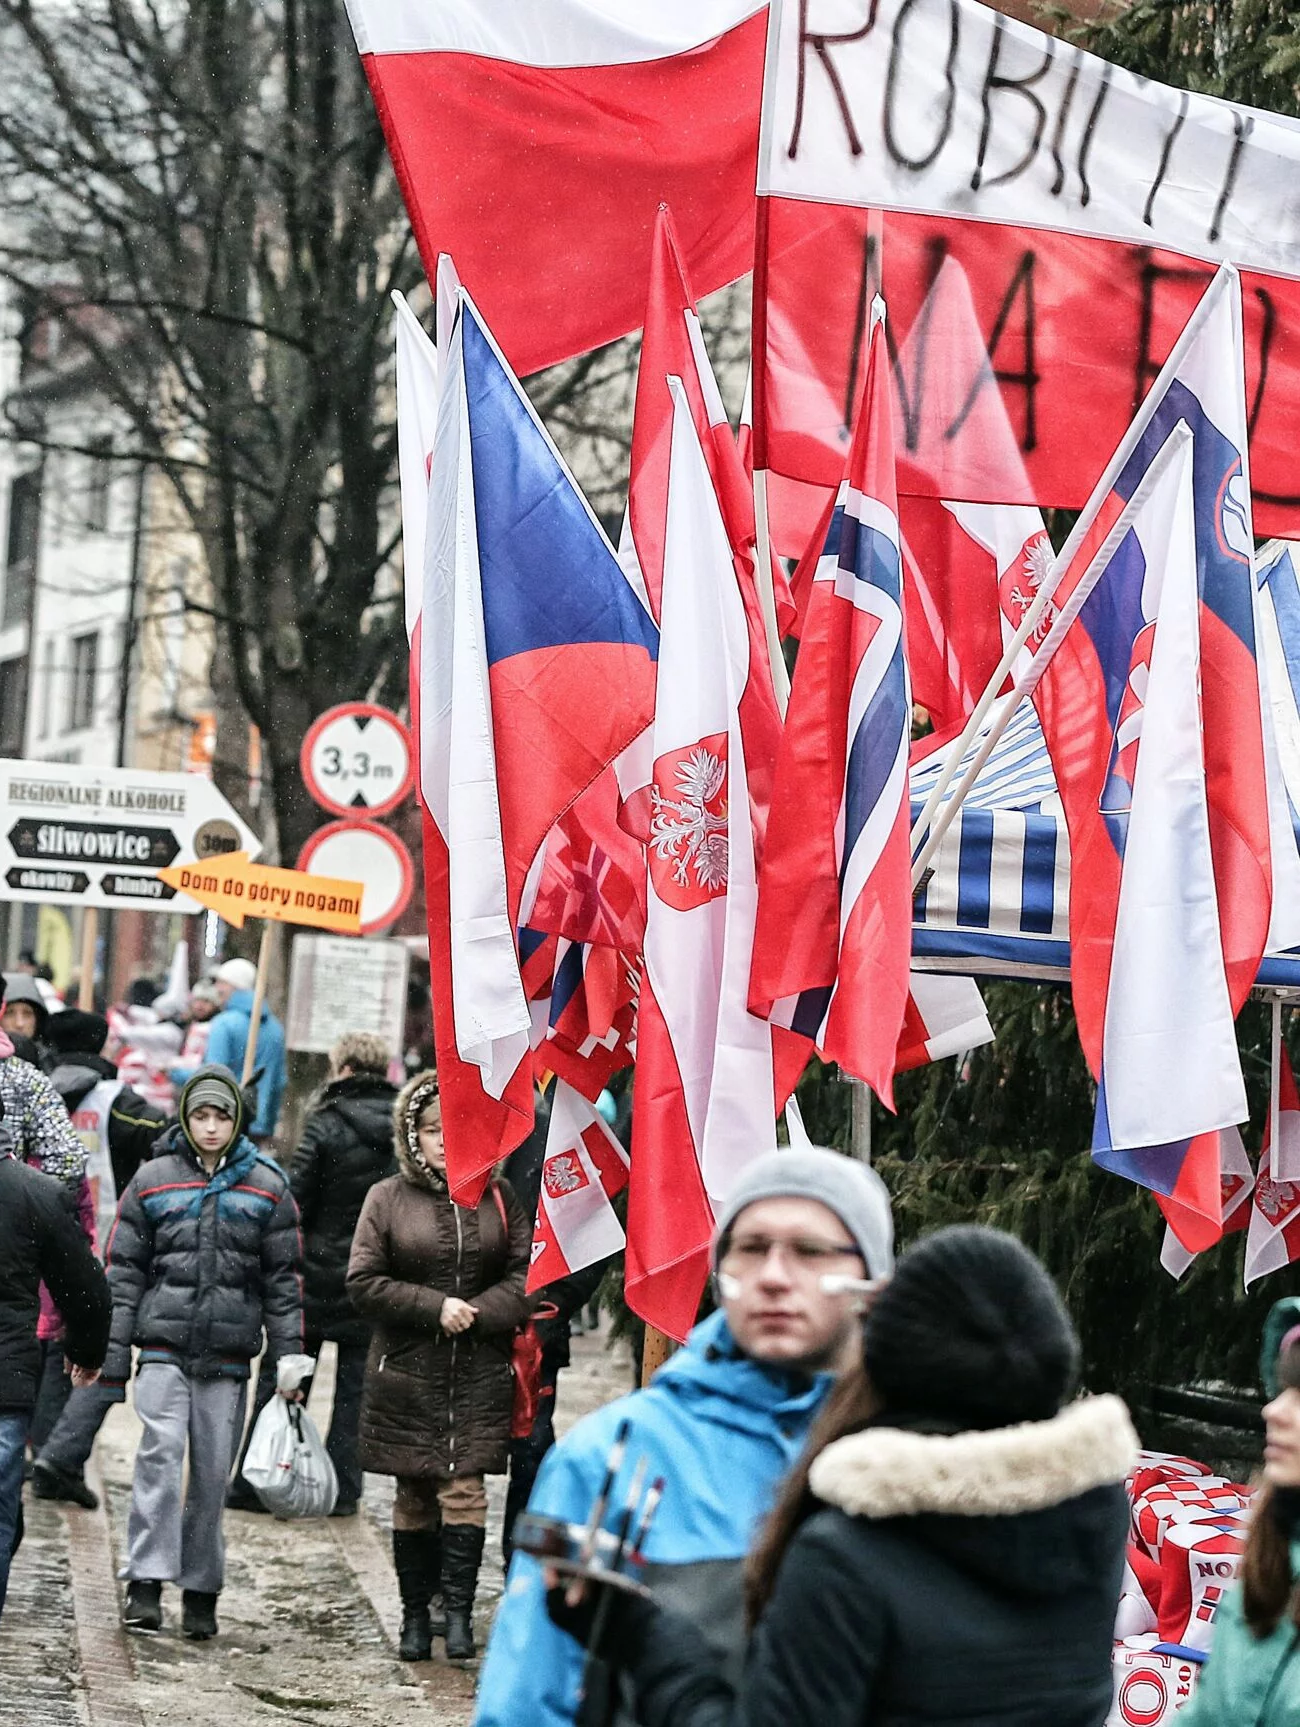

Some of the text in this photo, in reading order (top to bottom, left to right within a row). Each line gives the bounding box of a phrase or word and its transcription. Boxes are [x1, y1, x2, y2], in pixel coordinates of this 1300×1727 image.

[8, 782, 187, 812] REGIONALNE ALKOHOLE
[180, 870, 361, 915] Dom do góry nogami
